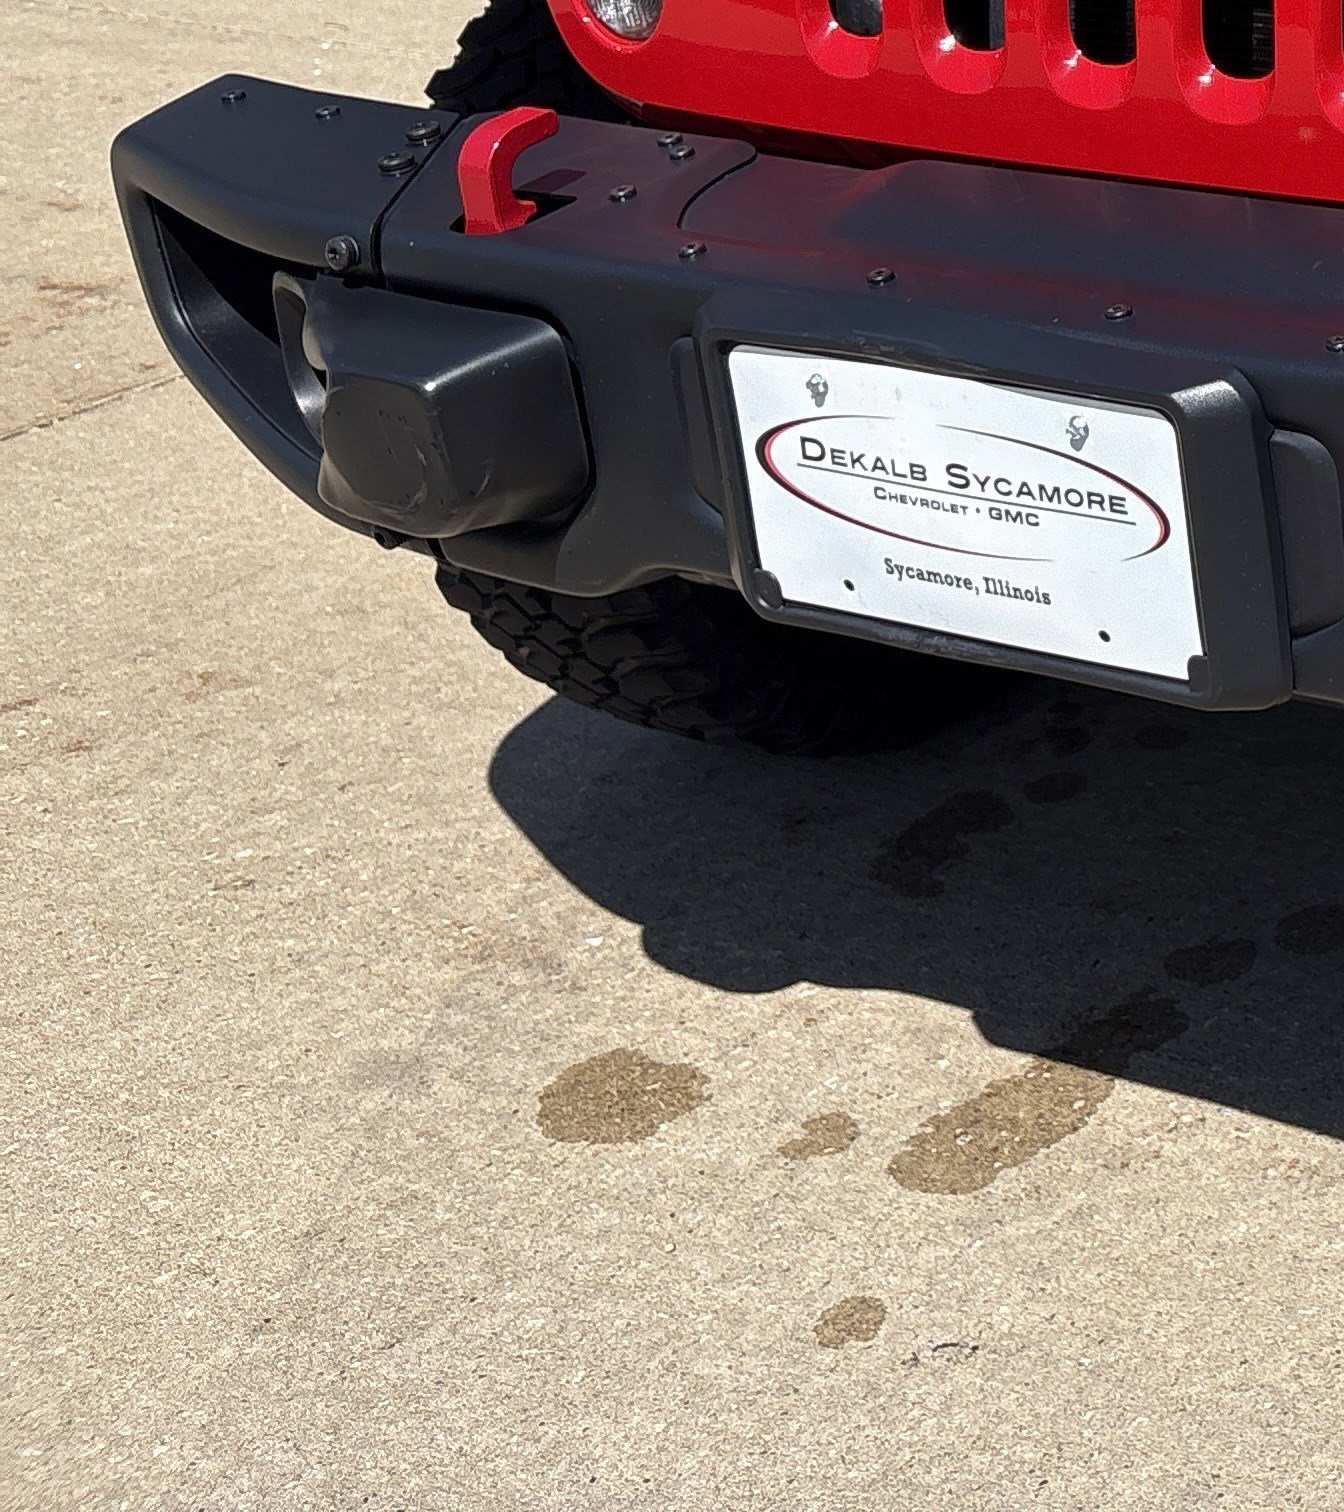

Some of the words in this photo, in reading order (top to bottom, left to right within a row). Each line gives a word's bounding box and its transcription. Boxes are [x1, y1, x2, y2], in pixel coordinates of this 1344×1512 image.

[988, 506, 1040, 527] GMC
[883, 556, 980, 596] Sycamore,
[982, 575, 1052, 606] Illinois
